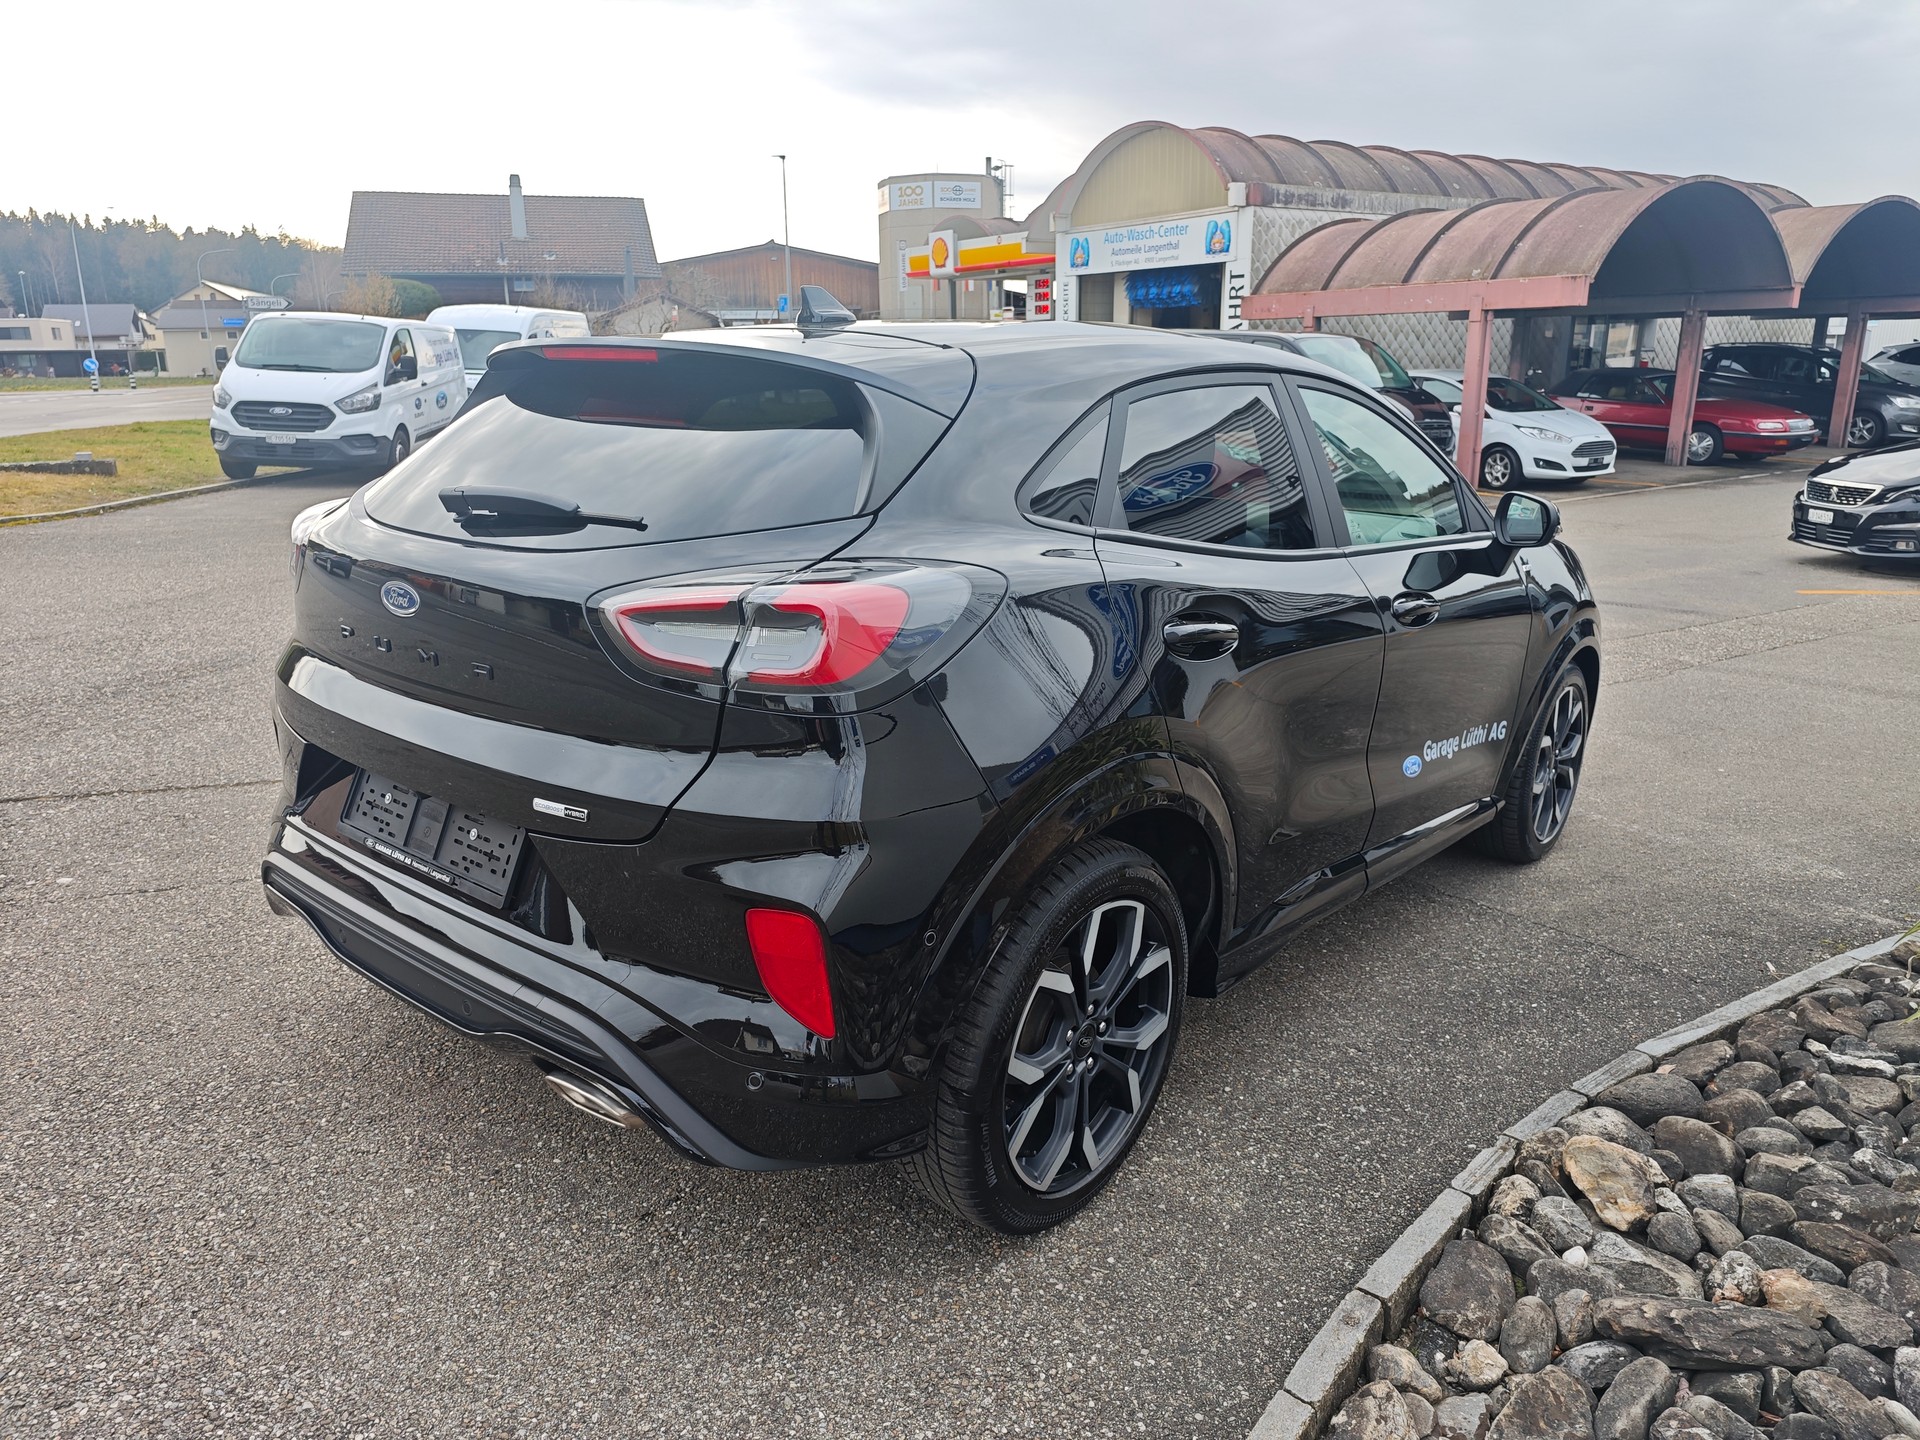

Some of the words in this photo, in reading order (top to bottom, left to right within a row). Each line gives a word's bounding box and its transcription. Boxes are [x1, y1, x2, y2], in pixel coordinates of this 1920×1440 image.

[898, 185, 924, 198] 100
[898, 198, 924, 207] JAHRE
[1104, 224, 1189, 245] Auto-Wasch-Center
[1110, 245, 1142, 257] Automeile
[1143, 240, 1180, 255] Langenthal
[340, 624, 495, 681] PUMA
[1423, 736, 1460, 762] Garage
[1460, 723, 1488, 750] Lüthi
[1488, 720, 1508, 742] AG
[564, 808, 585, 819] HYBRID
[375, 843, 392, 856] GARAGE
[404, 857, 412, 865] AG
